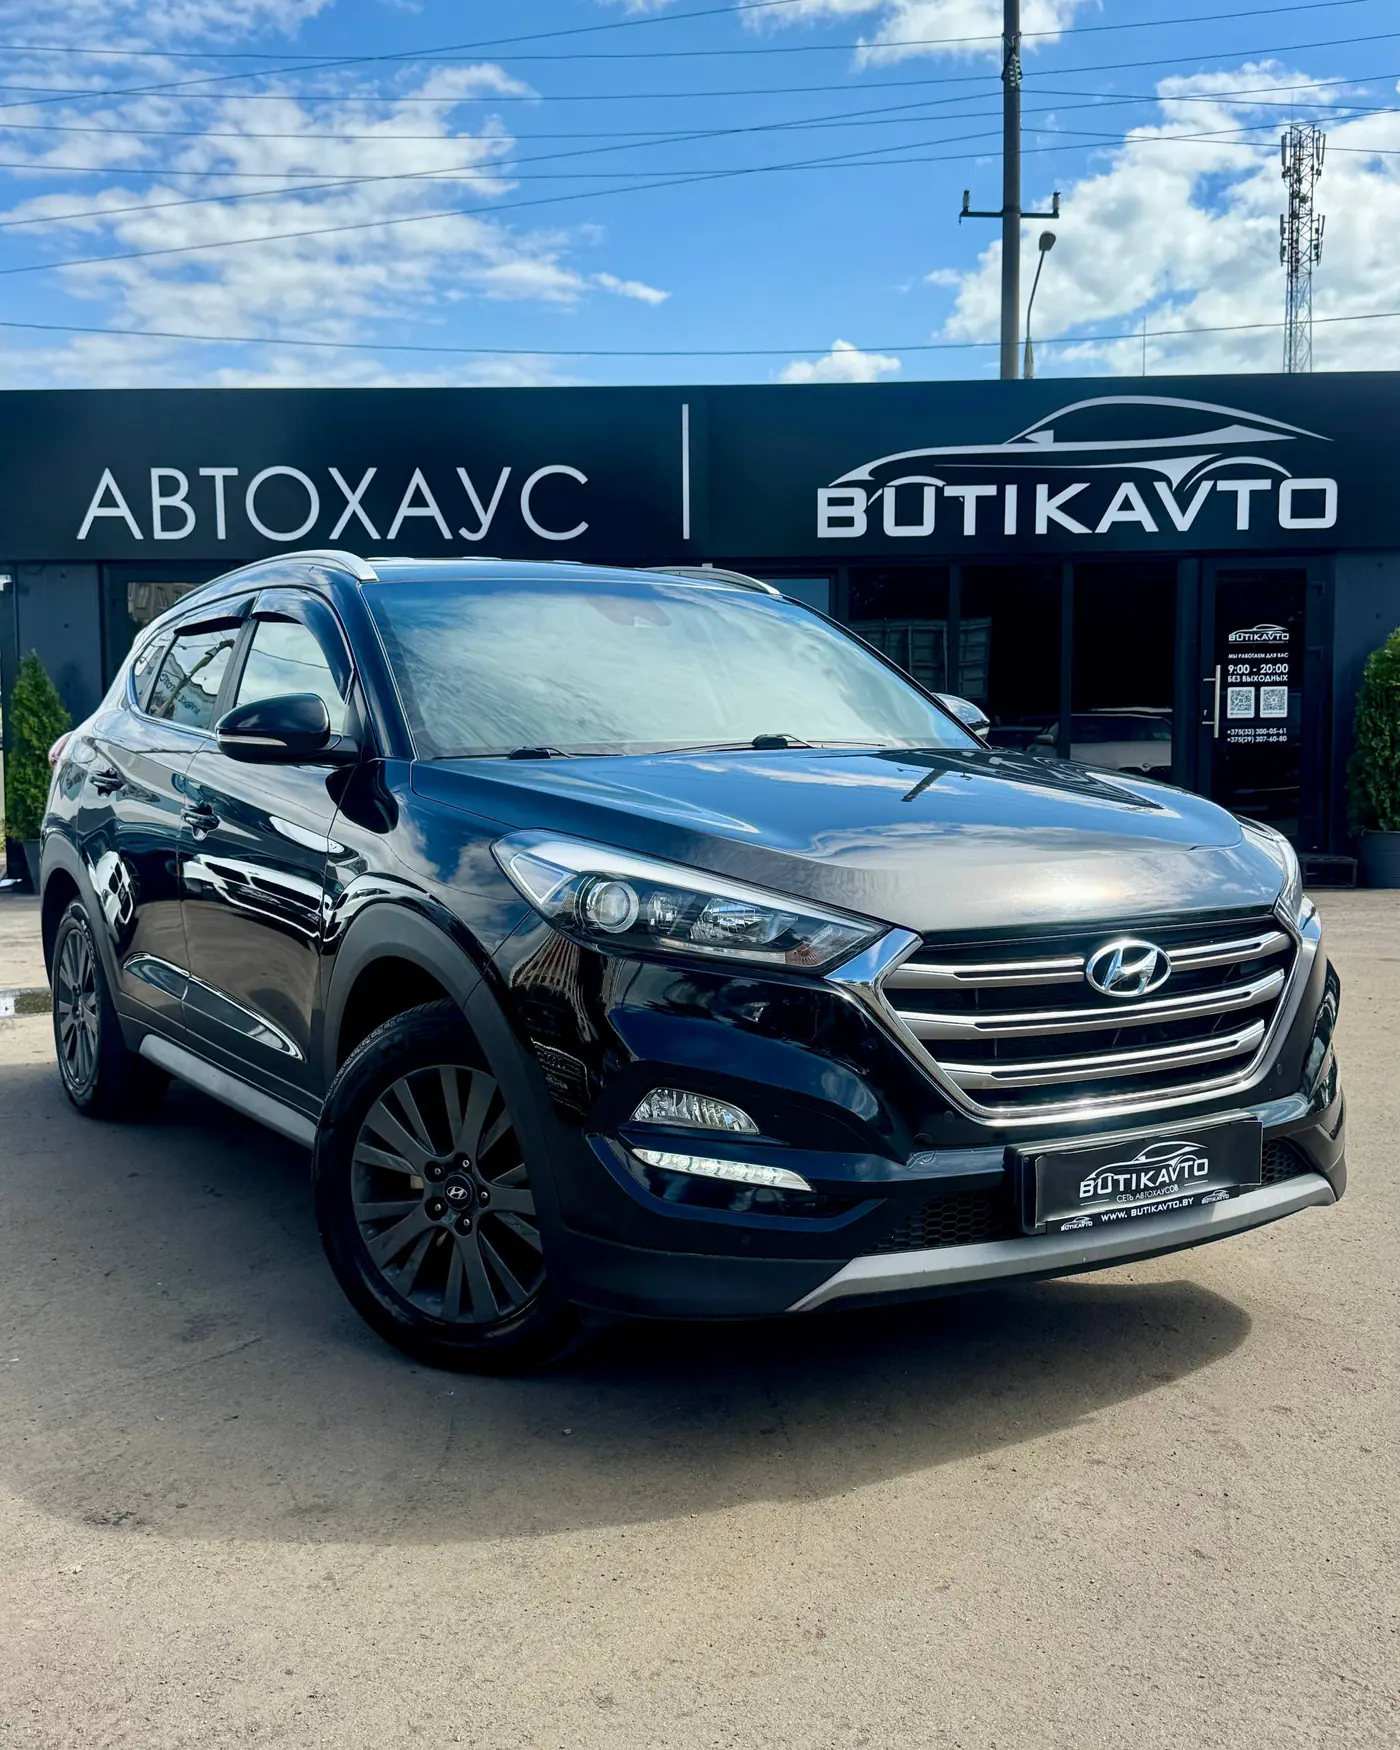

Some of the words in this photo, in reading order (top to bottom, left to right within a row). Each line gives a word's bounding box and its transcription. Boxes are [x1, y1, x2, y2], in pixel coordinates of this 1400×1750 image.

[76, 465, 589, 541] АВТОХАУС
[817, 477, 1338, 538] BUTIKAVTO
[1228, 633, 1289, 641] BUTIKAVTO
[1228, 664, 1250, 674] 9:00
[1260, 663, 1289, 674] 20:00
[1242, 674, 1288, 682] ВЫХОДНЫХ
[1079, 1158, 1209, 1198] BUTIKAVTO
[1116, 1193, 1134, 1203] СЕТЬ
[1135, 1184, 1179, 1200] АВТОХАУСОВ
[1101, 1211, 1127, 1222] WWW.
[1130, 1197, 1194, 1217] BUTIKAVTO.BY
